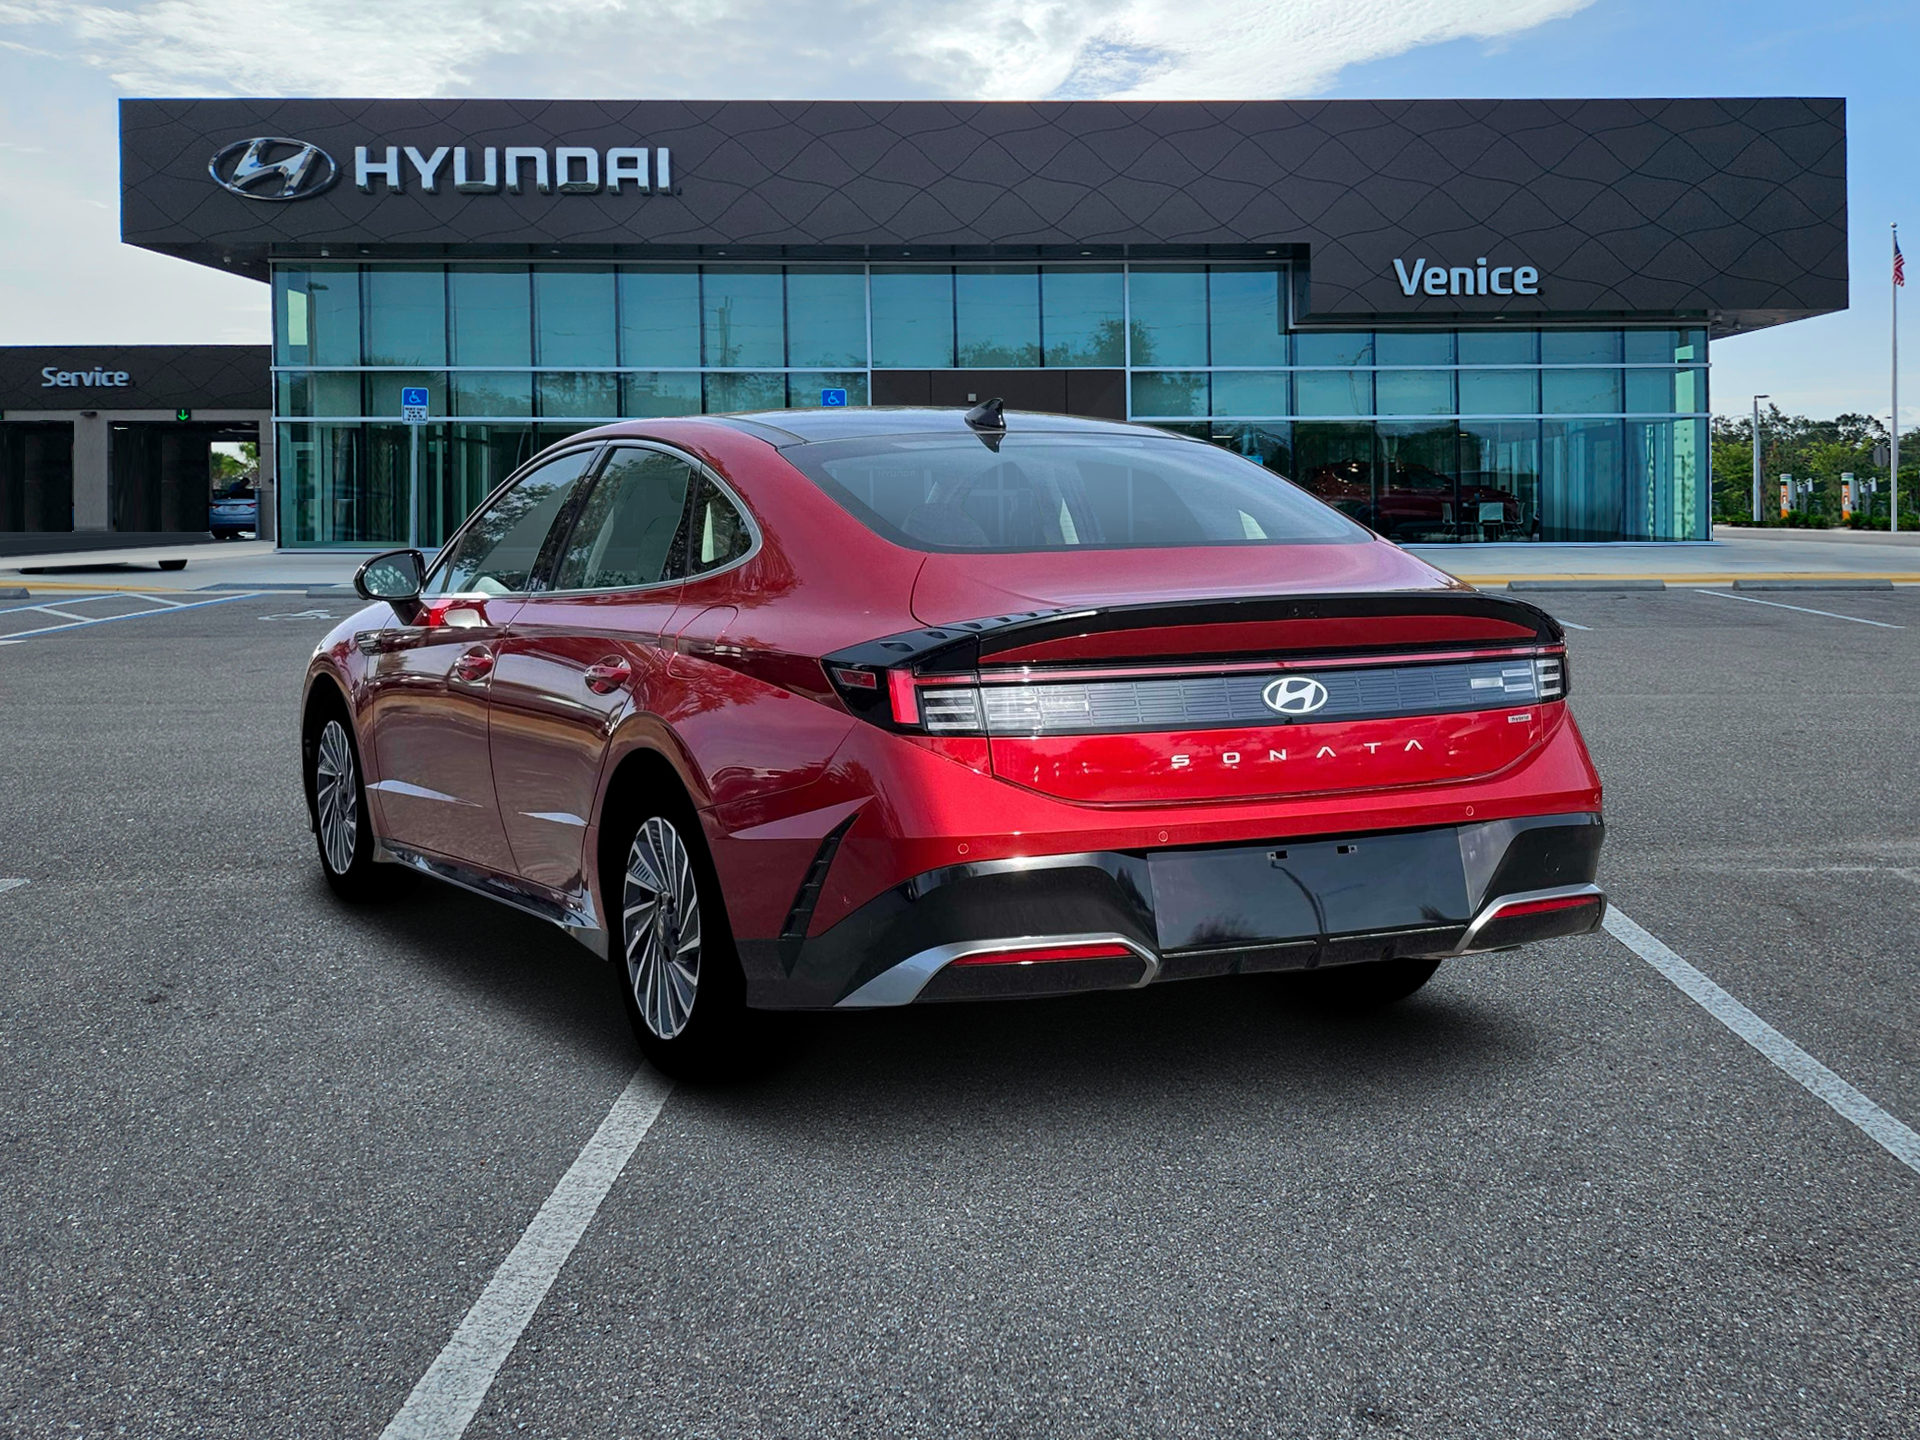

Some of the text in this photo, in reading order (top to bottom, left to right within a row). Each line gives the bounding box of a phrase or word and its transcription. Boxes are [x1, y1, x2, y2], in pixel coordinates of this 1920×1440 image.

[355, 146, 671, 193] HYUNDAI
[1392, 257, 1539, 296] Venice
[41, 366, 130, 387] Service
[1170, 739, 1424, 767] SONATA
